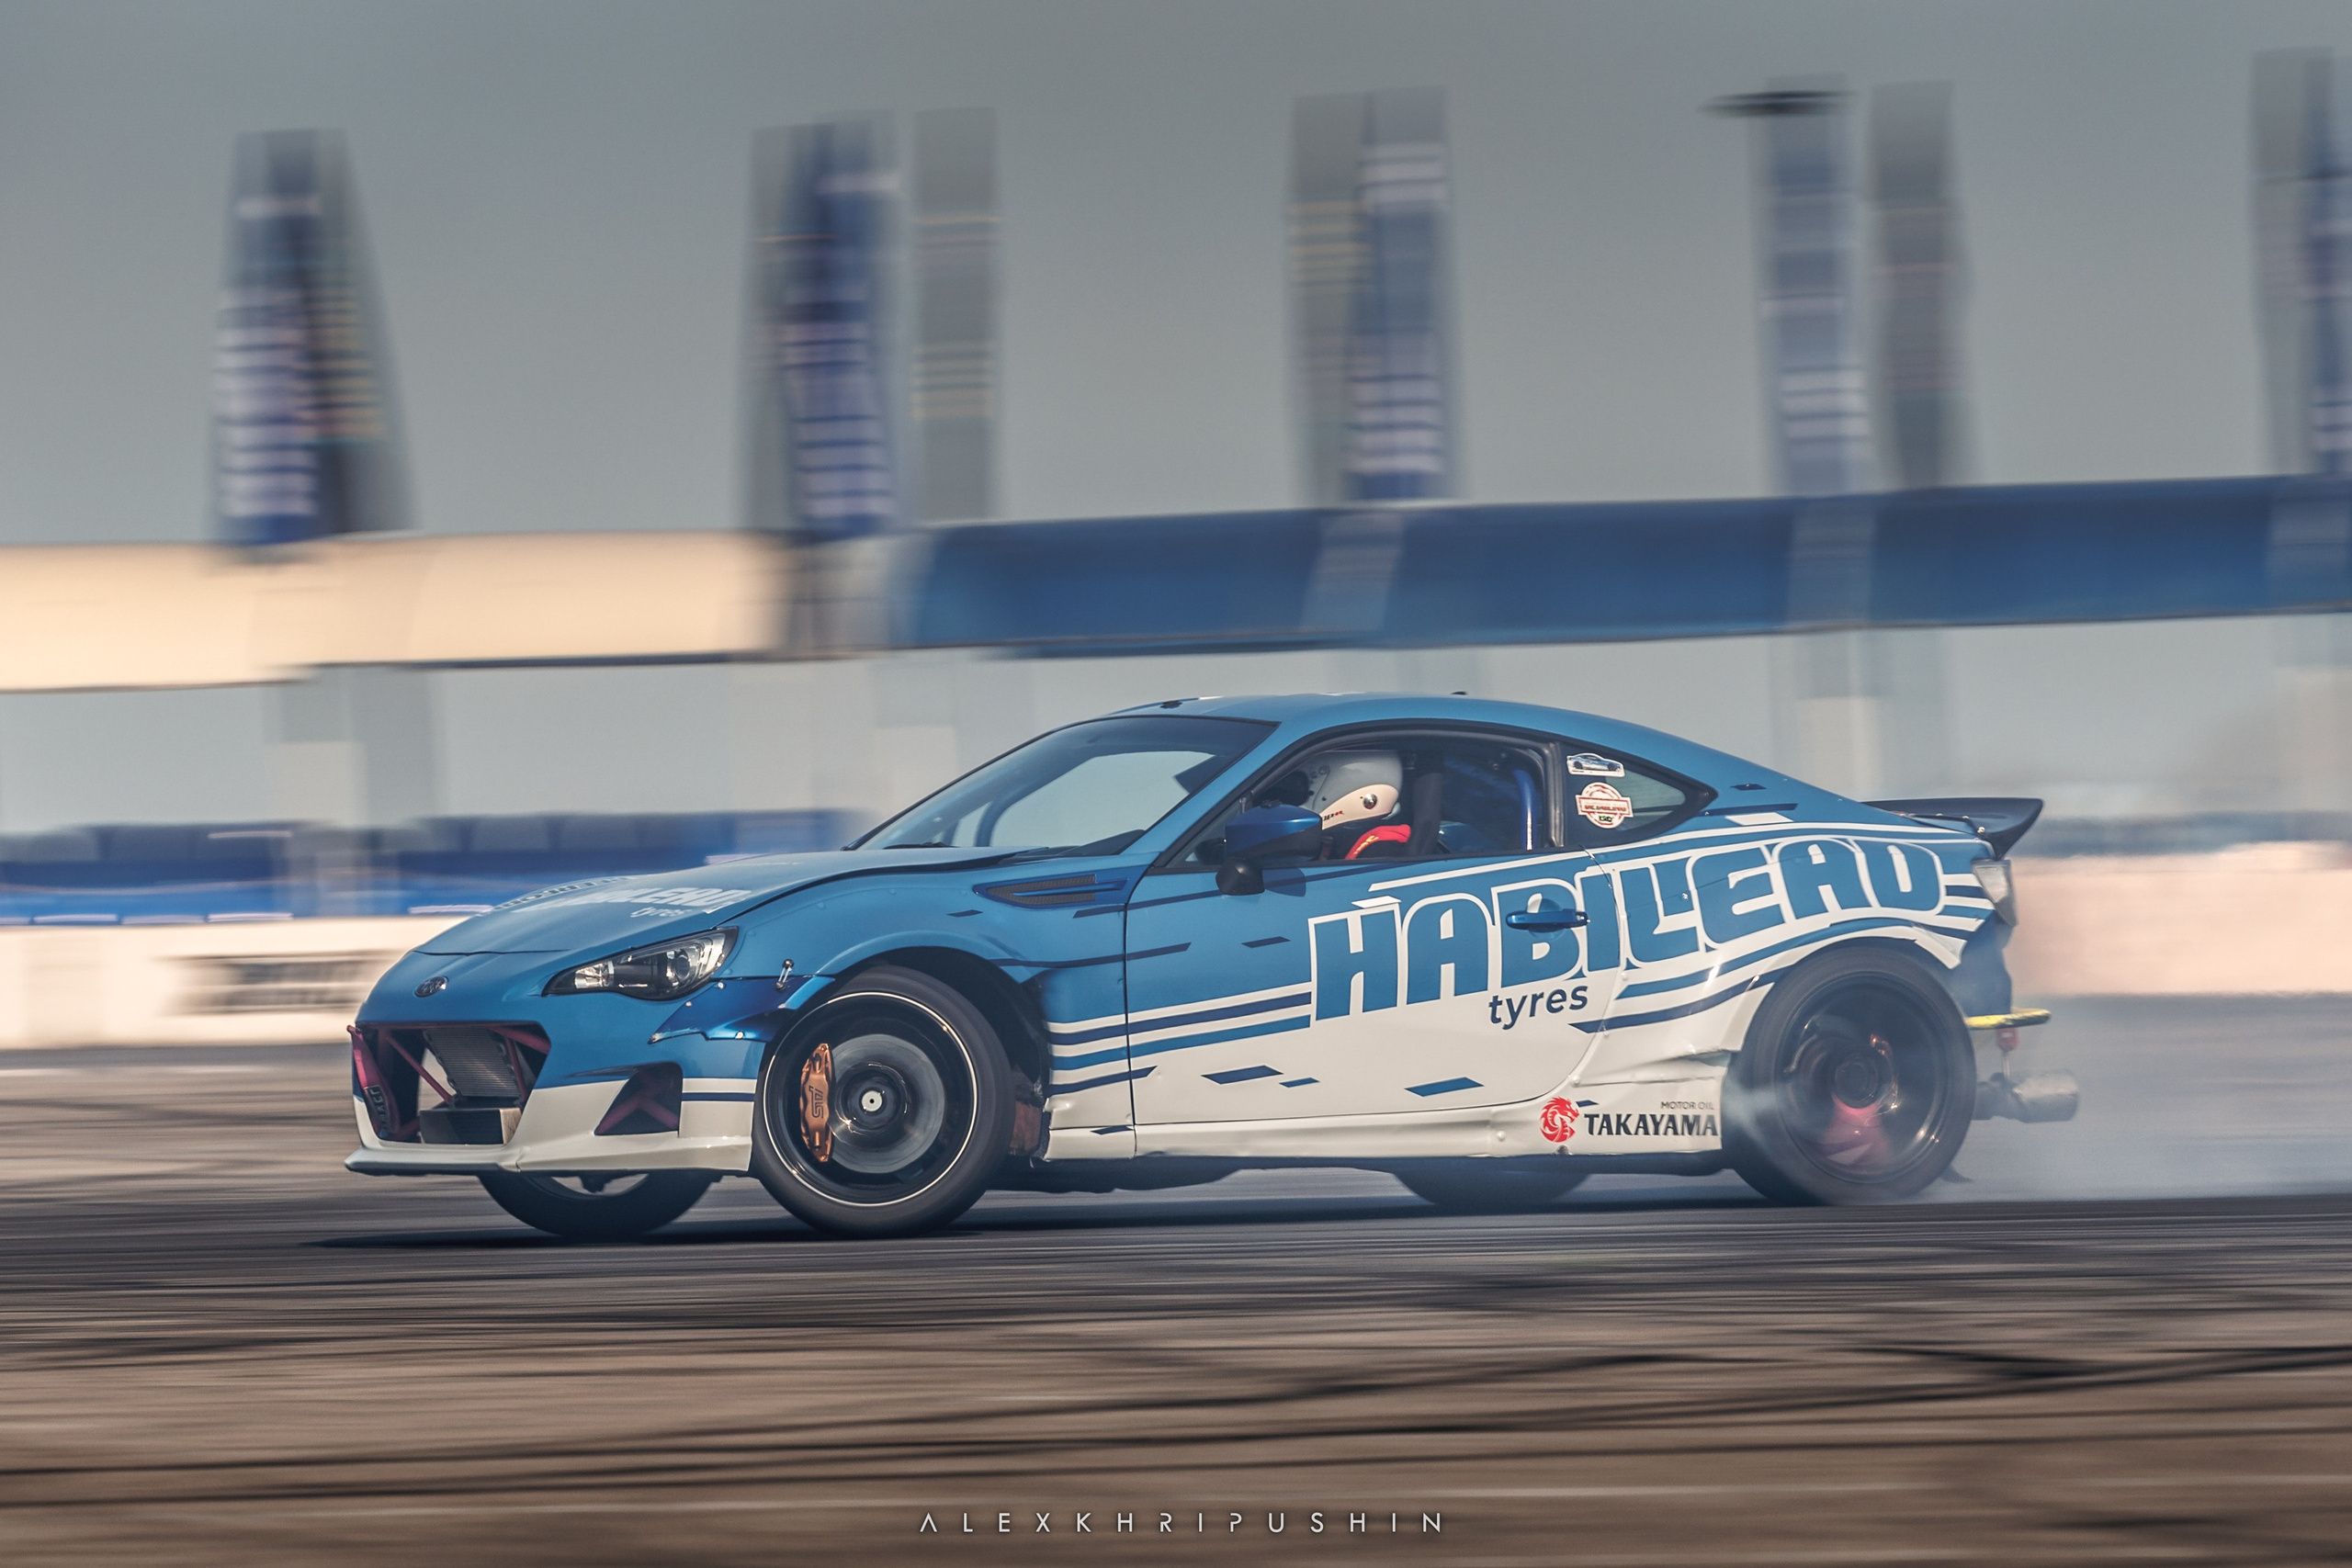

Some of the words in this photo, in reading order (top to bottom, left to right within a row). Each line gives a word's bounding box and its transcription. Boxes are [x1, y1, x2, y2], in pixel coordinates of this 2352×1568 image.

[1313, 838, 1943, 1021] HABILEAD
[1488, 986, 1589, 1030] tyres
[1660, 1101, 1697, 1110] MOTOR
[1698, 1101, 1714, 1110] OIL
[1584, 1113, 1718, 1136] TAKAYAMA
